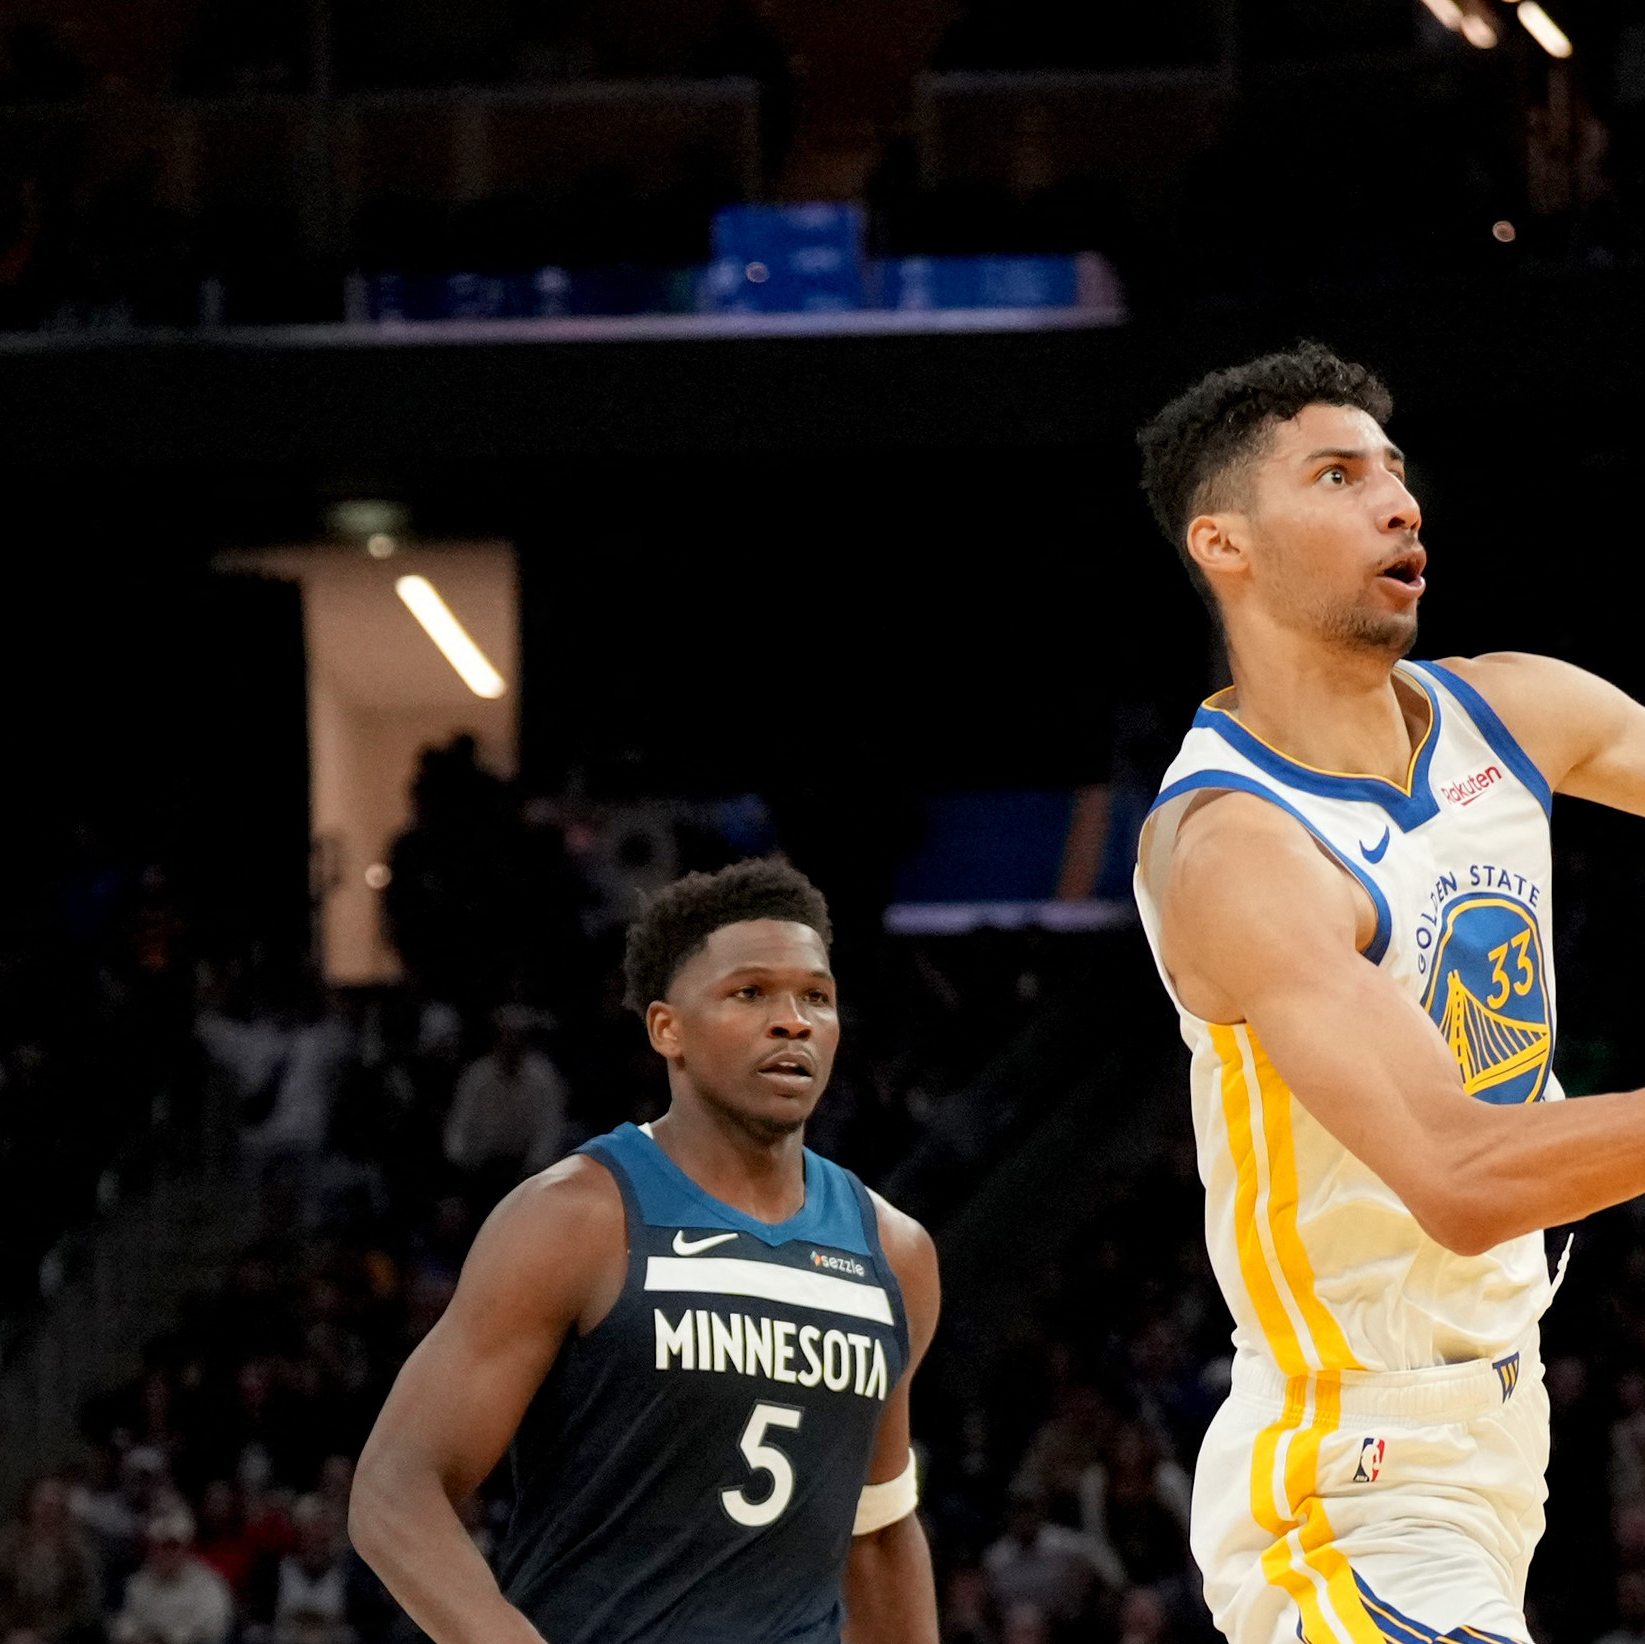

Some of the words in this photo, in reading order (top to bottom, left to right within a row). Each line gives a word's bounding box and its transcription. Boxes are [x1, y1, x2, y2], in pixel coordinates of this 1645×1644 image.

[1441, 764, 1503, 807] Rakuten
[1416, 871, 1457, 974] GOLDEN
[1470, 864, 1541, 909] STATE
[1486, 928, 1534, 1011] 33
[820, 1255, 865, 1277] sezzle
[654, 1307, 888, 1400] MINNESOTA
[722, 1403, 802, 1526] 5
